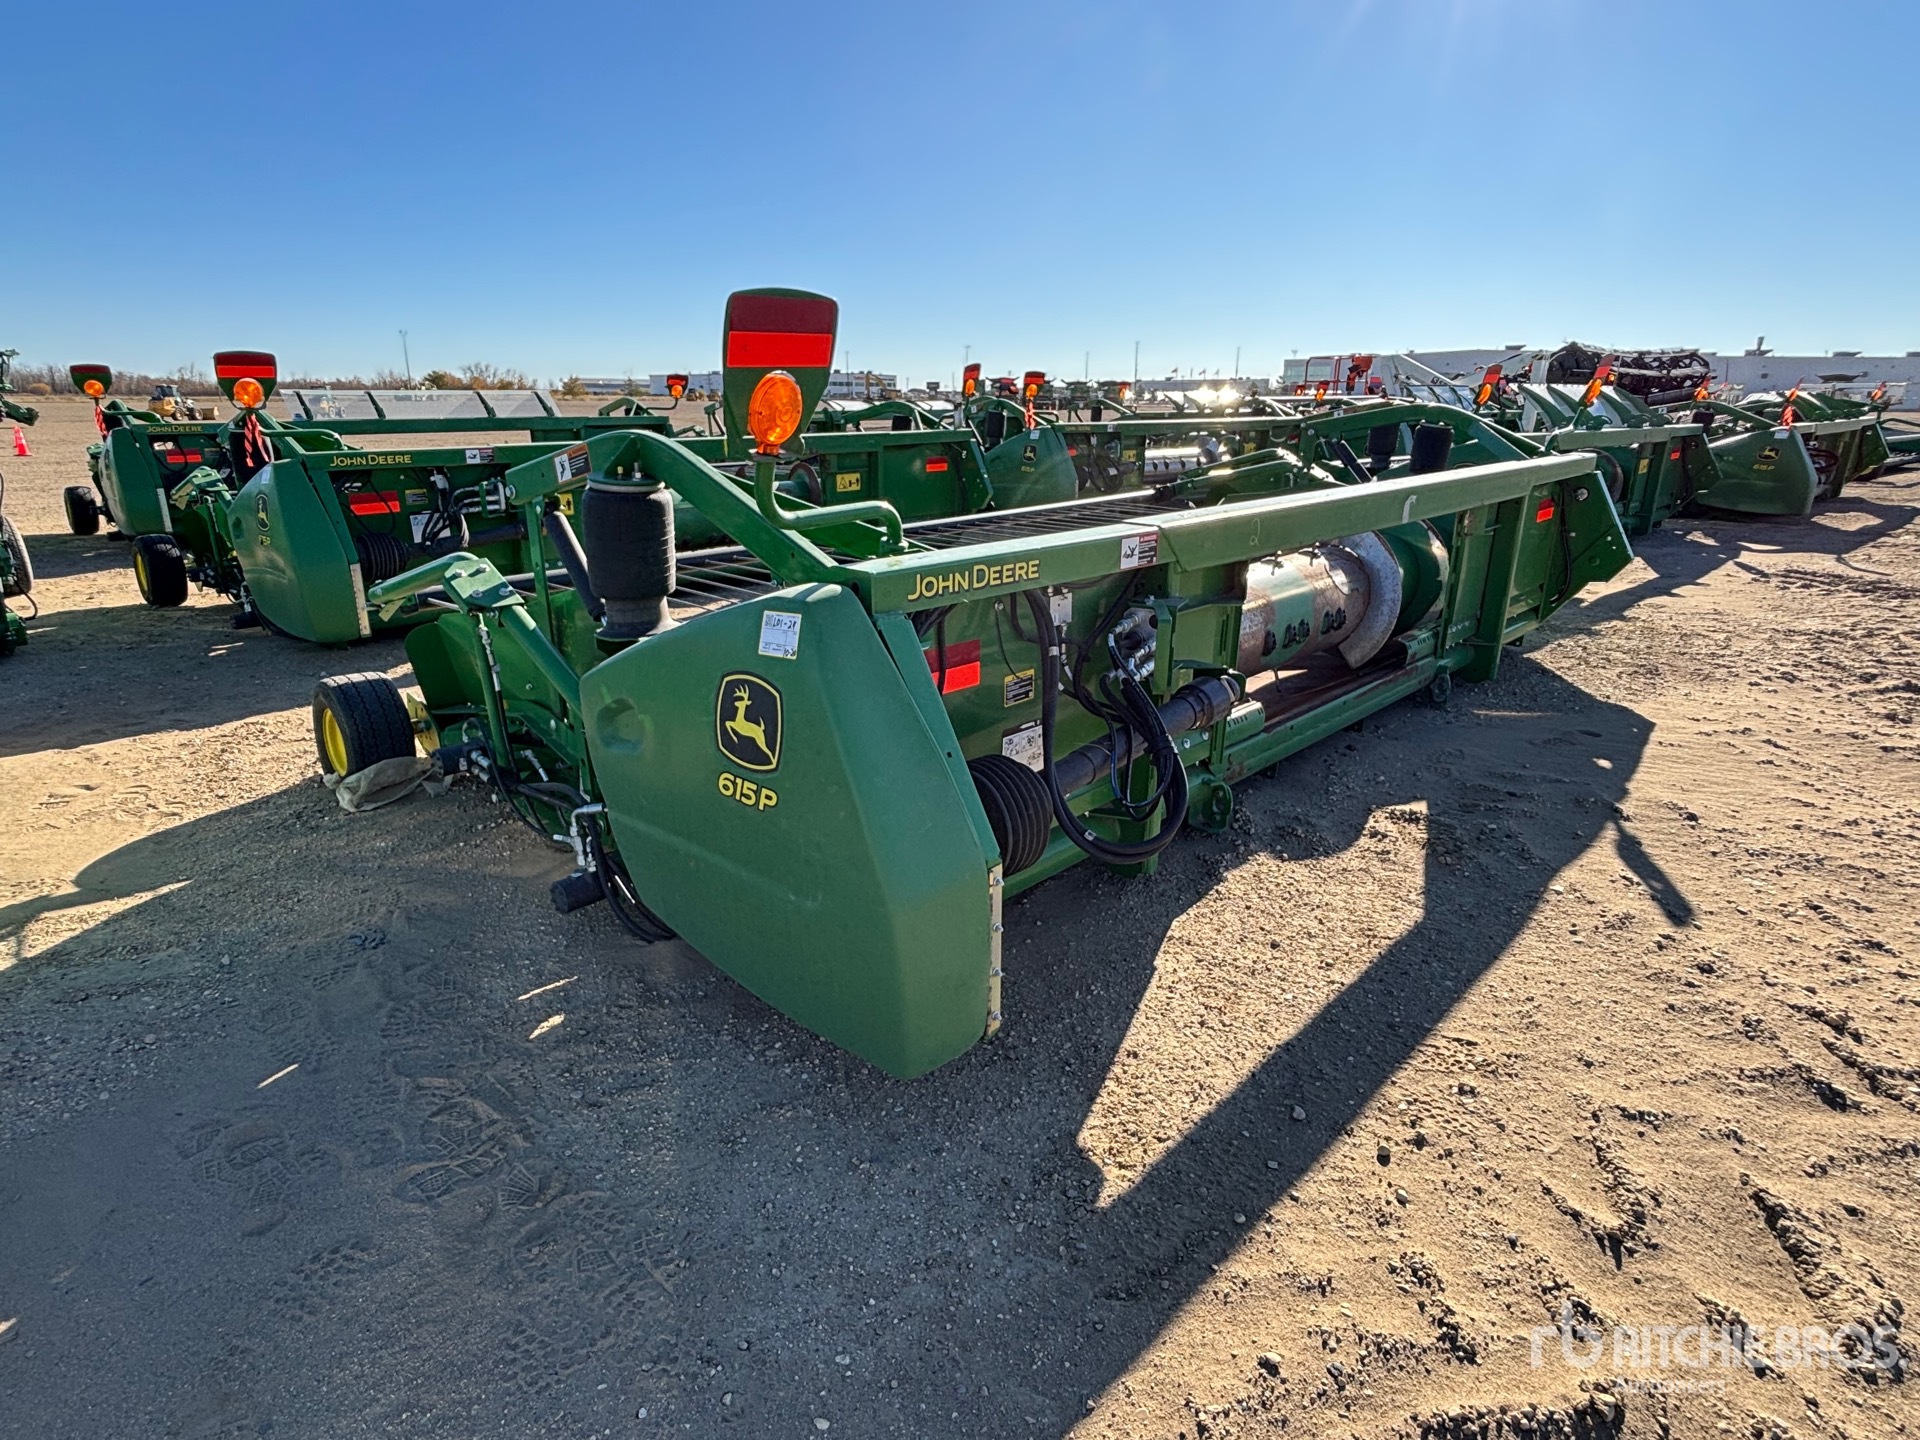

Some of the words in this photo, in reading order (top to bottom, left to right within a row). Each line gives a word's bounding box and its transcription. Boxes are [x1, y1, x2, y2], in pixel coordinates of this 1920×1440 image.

[147, 425, 171, 433] JOHN
[330, 456, 366, 467] JOHN
[368, 454, 412, 465] DEERE
[907, 570, 970, 602] JOHN
[972, 559, 1040, 590] DEERE
[718, 771, 778, 811] 615P
